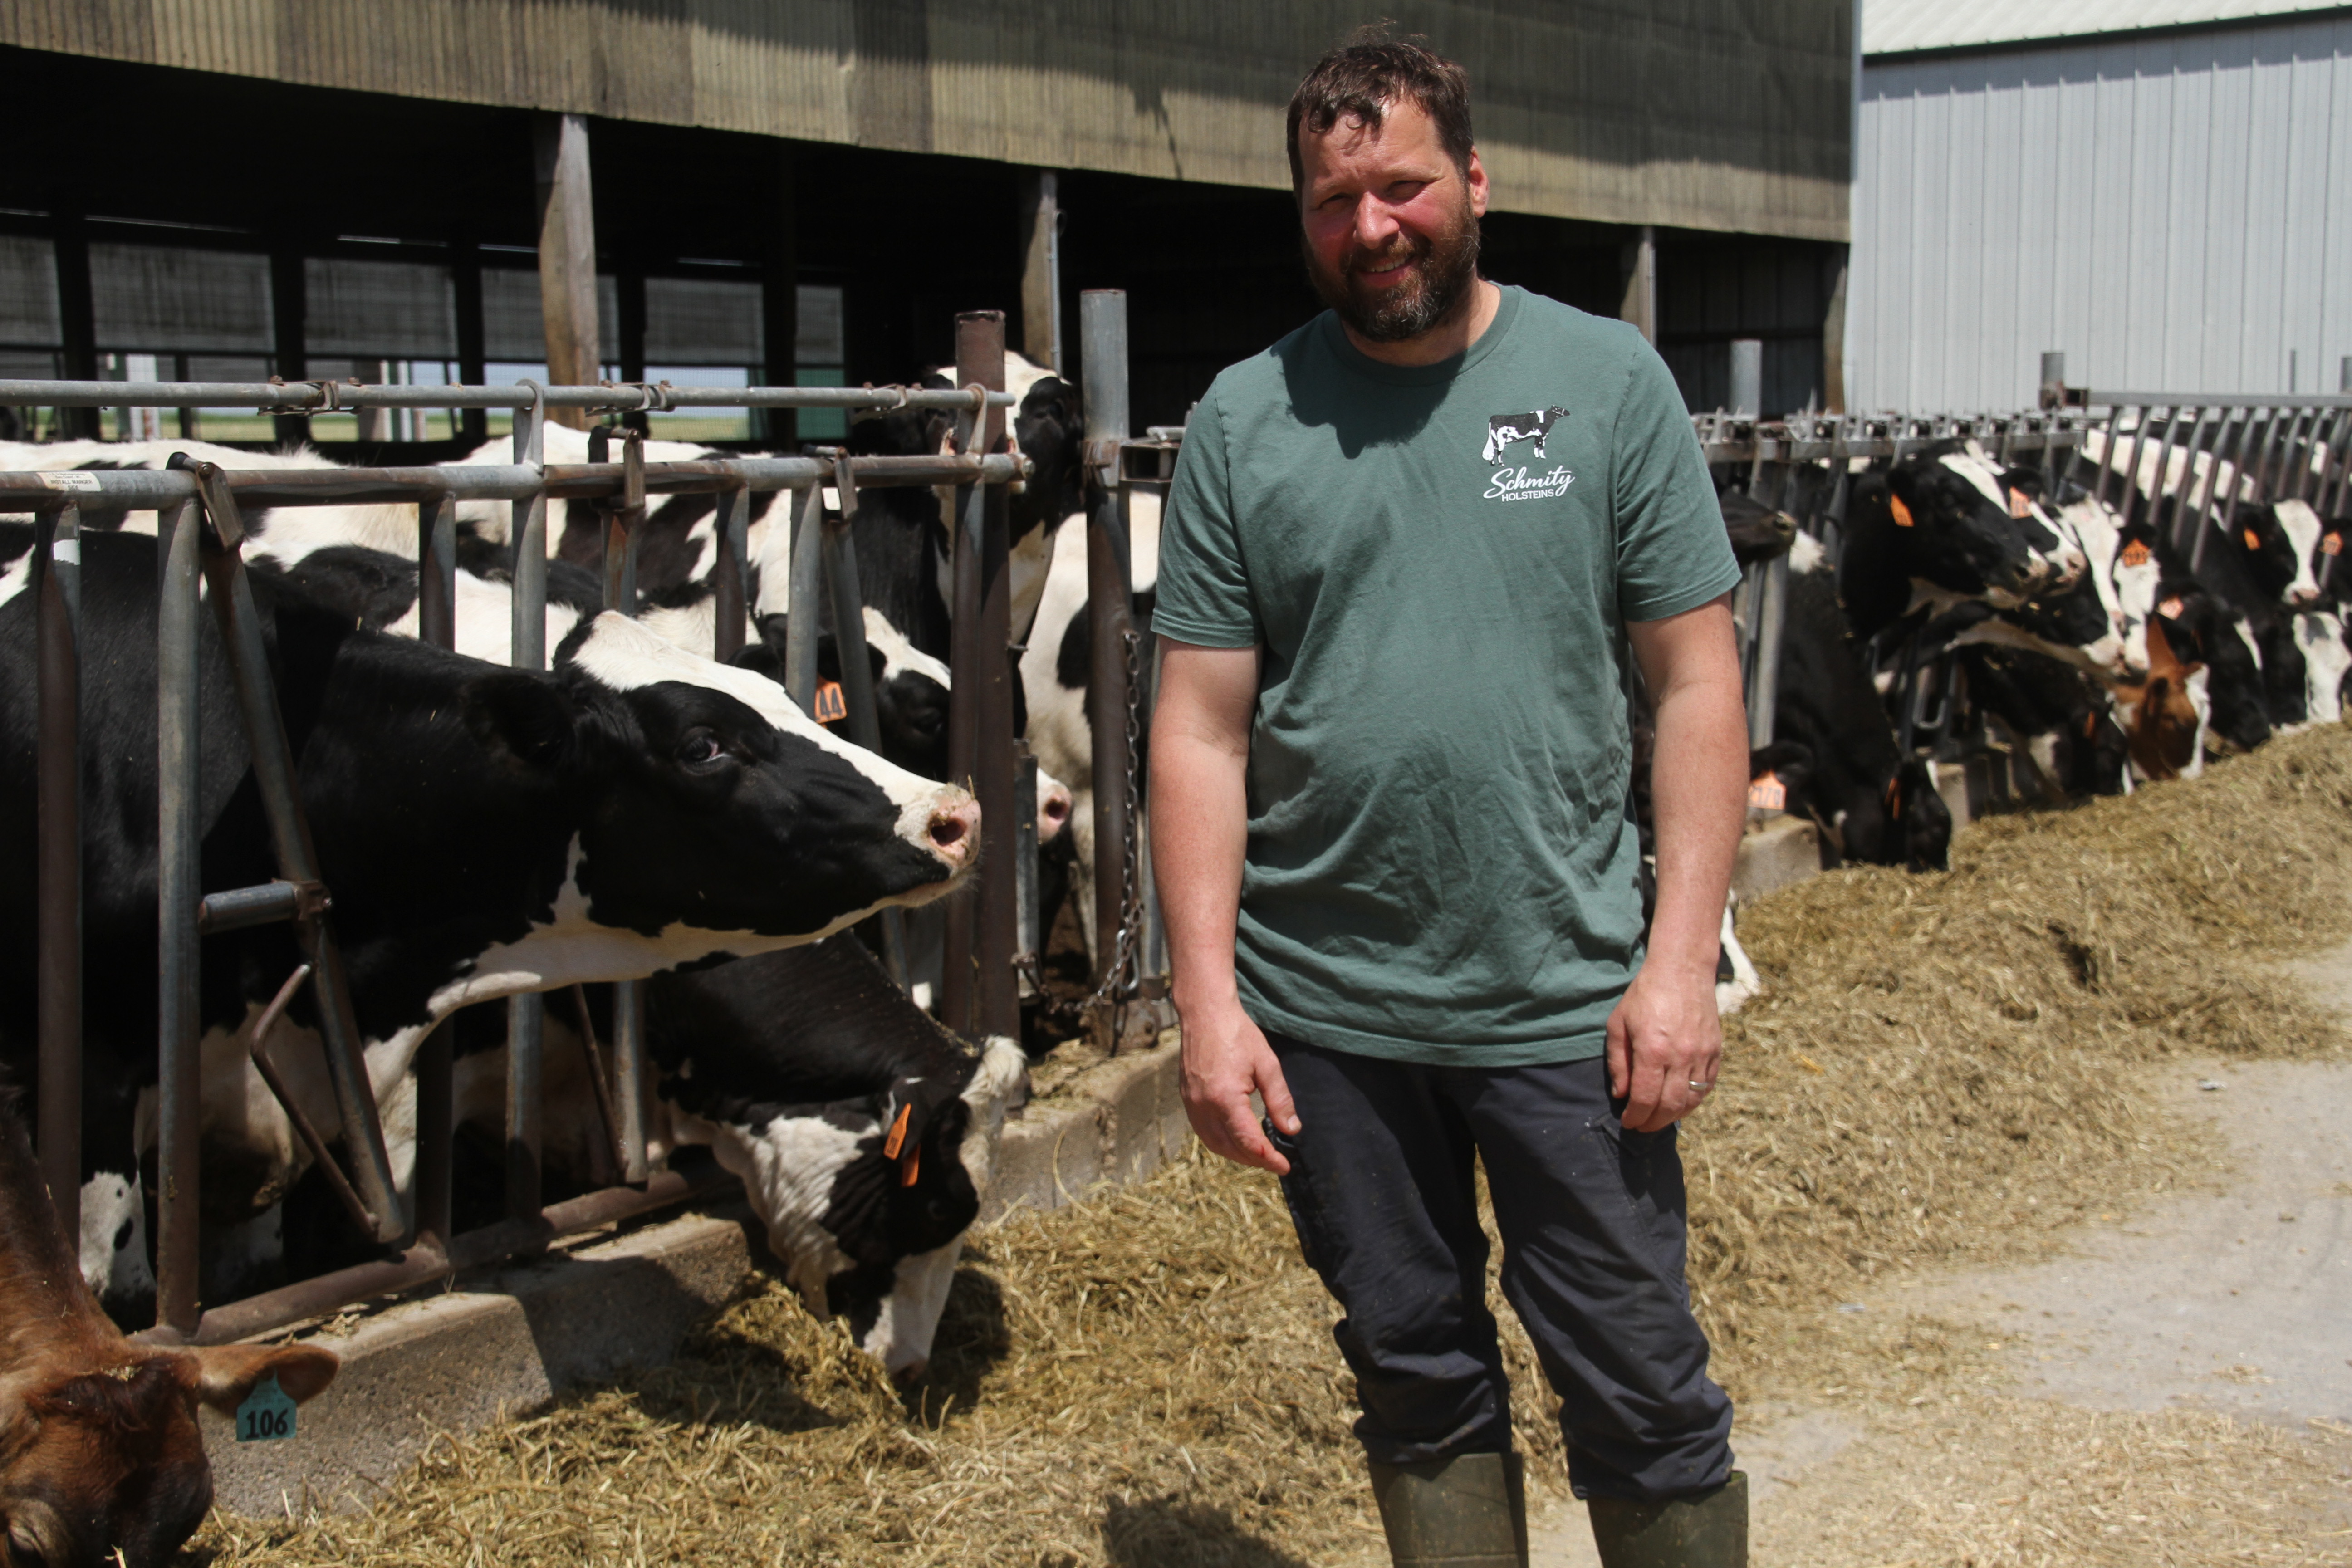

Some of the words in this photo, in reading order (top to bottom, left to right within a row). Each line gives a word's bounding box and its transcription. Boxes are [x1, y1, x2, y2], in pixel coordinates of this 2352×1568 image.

[1483, 465, 1576, 499] Schmity
[1501, 489, 1554, 502] HOLSTEINS
[245, 1408, 289, 1439] 106
